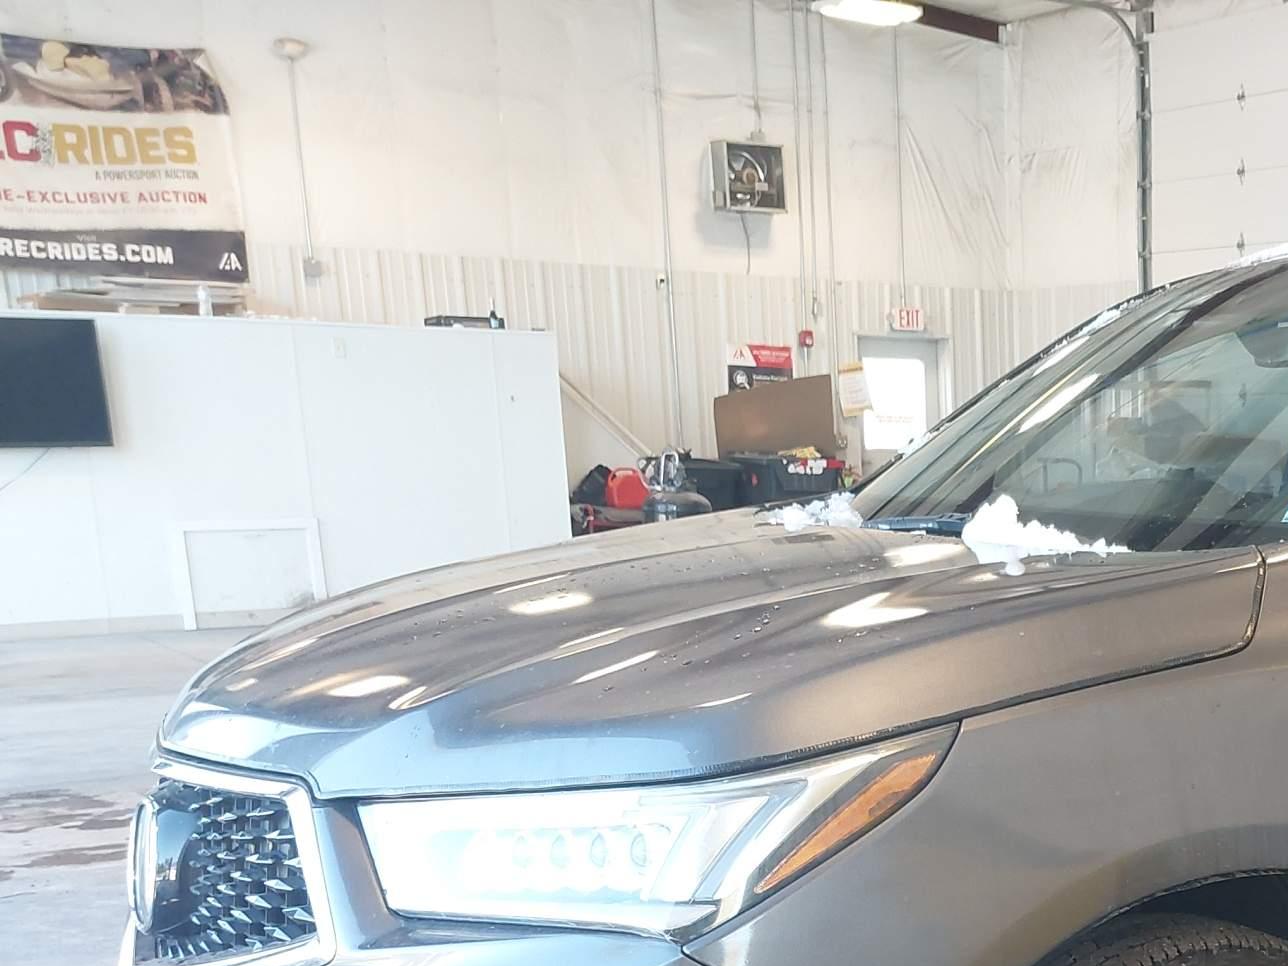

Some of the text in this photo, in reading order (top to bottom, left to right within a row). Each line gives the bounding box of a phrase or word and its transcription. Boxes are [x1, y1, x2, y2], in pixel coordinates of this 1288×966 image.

[0, 120, 197, 165] C RIDES
[0, 188, 208, 204] E-EXCLUSIVE AUCTION
[0, 237, 174, 265] RECRIDES.COM
[899, 309, 920, 328] EXIT
